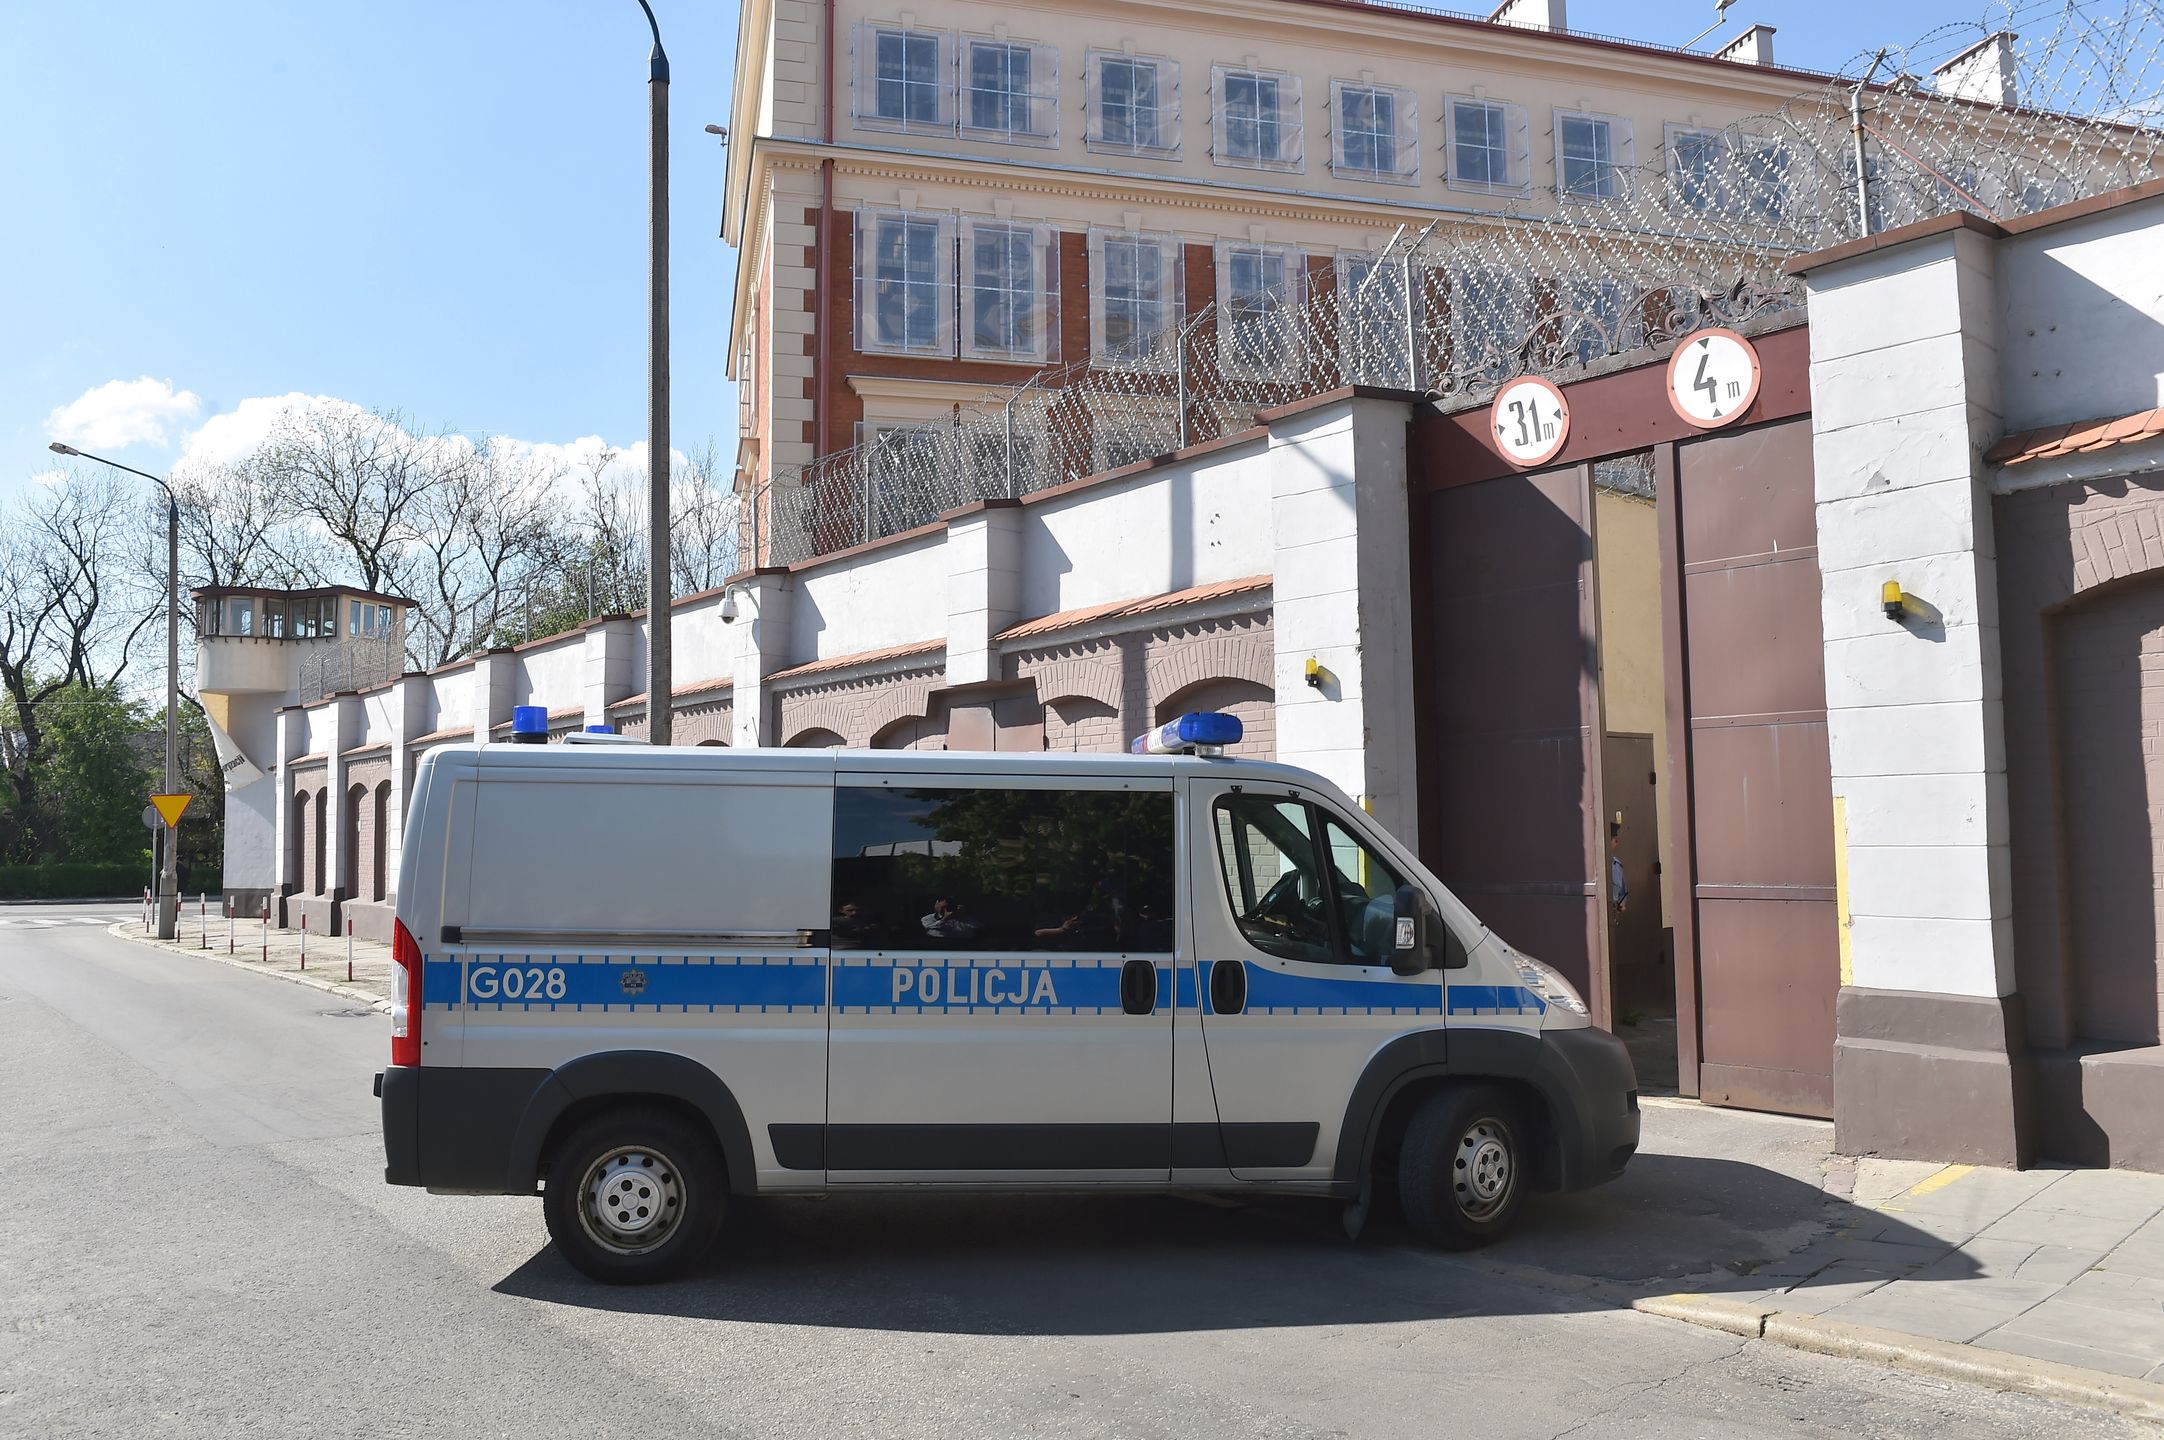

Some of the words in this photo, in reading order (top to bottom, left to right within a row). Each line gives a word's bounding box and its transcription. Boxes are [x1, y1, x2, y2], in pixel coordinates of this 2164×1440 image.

[1694, 354, 1717, 403] 4
[1726, 381, 1740, 398] m
[469, 966, 566, 999] G028
[891, 967, 1058, 1005] POLICJA
